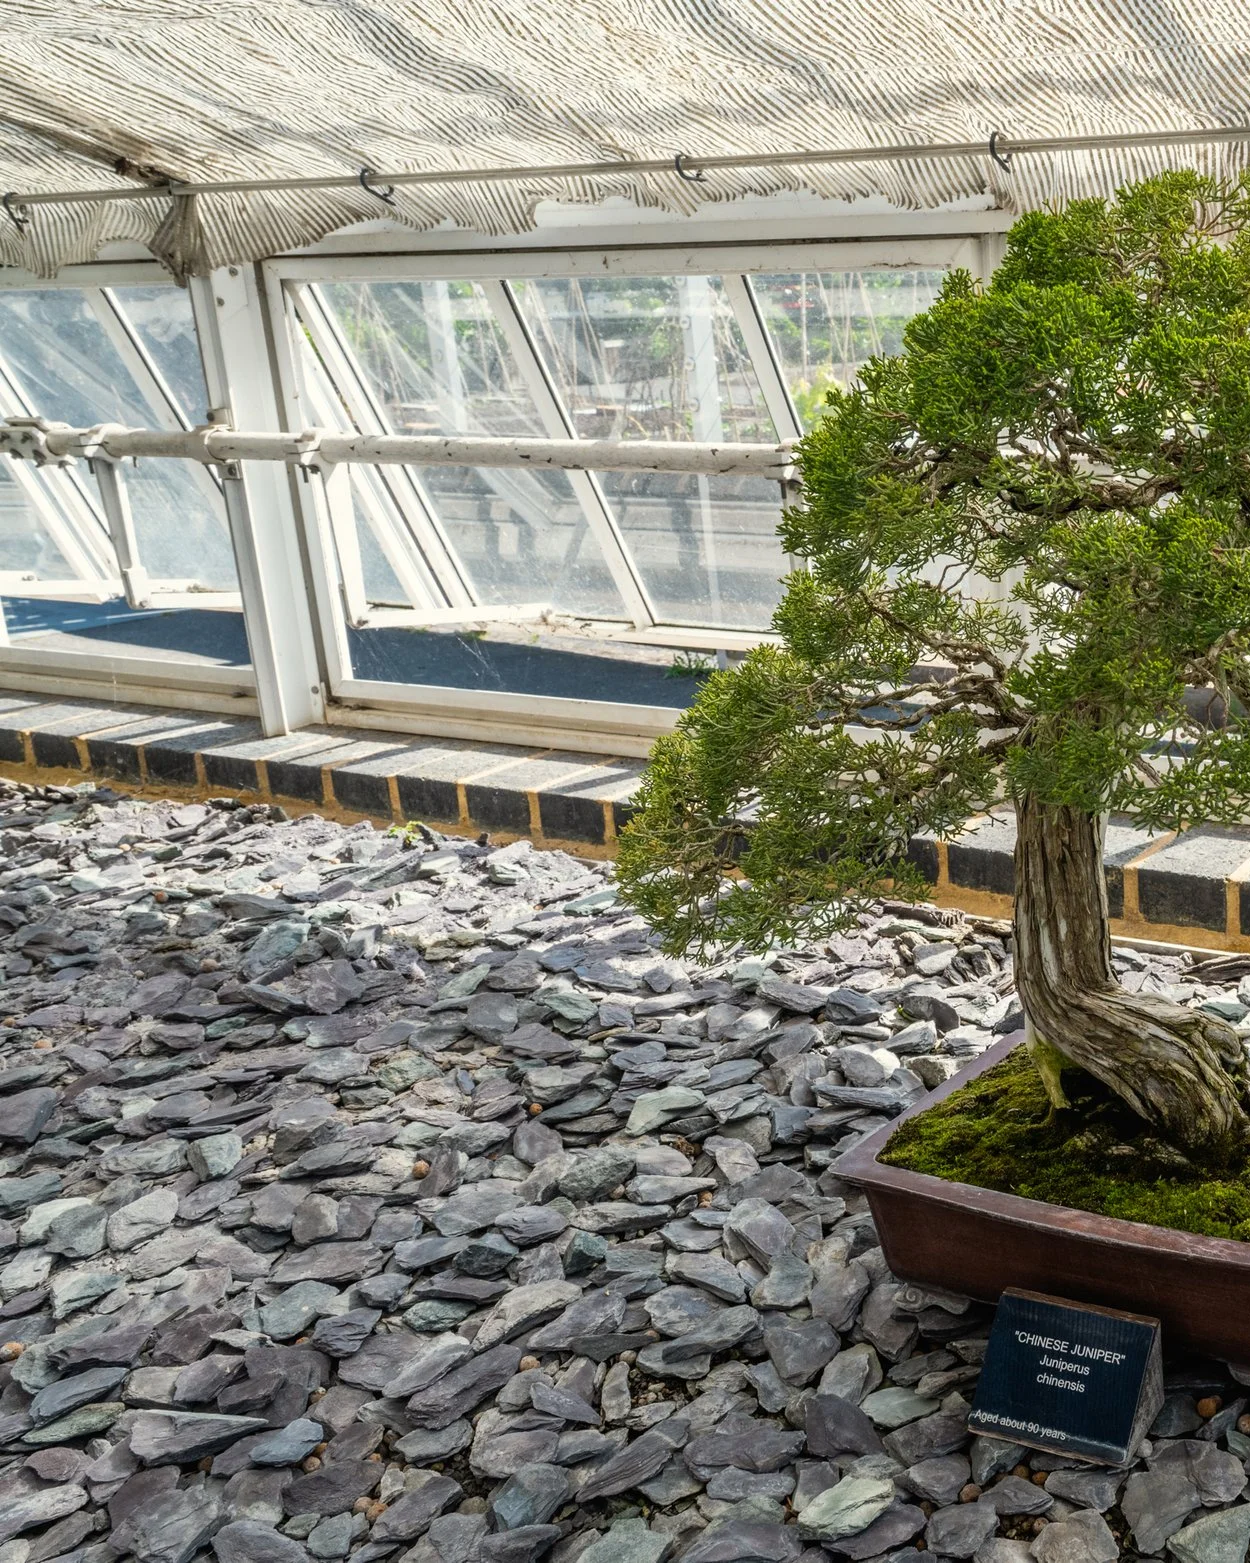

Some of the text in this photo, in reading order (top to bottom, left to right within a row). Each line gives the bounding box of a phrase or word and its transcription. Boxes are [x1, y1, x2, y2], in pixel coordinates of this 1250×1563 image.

[1039, 1354, 1090, 1376] Juniperus
[1036, 1373, 1086, 1393] chinensis
[974, 1409, 1066, 1441] Aged about 90 years
